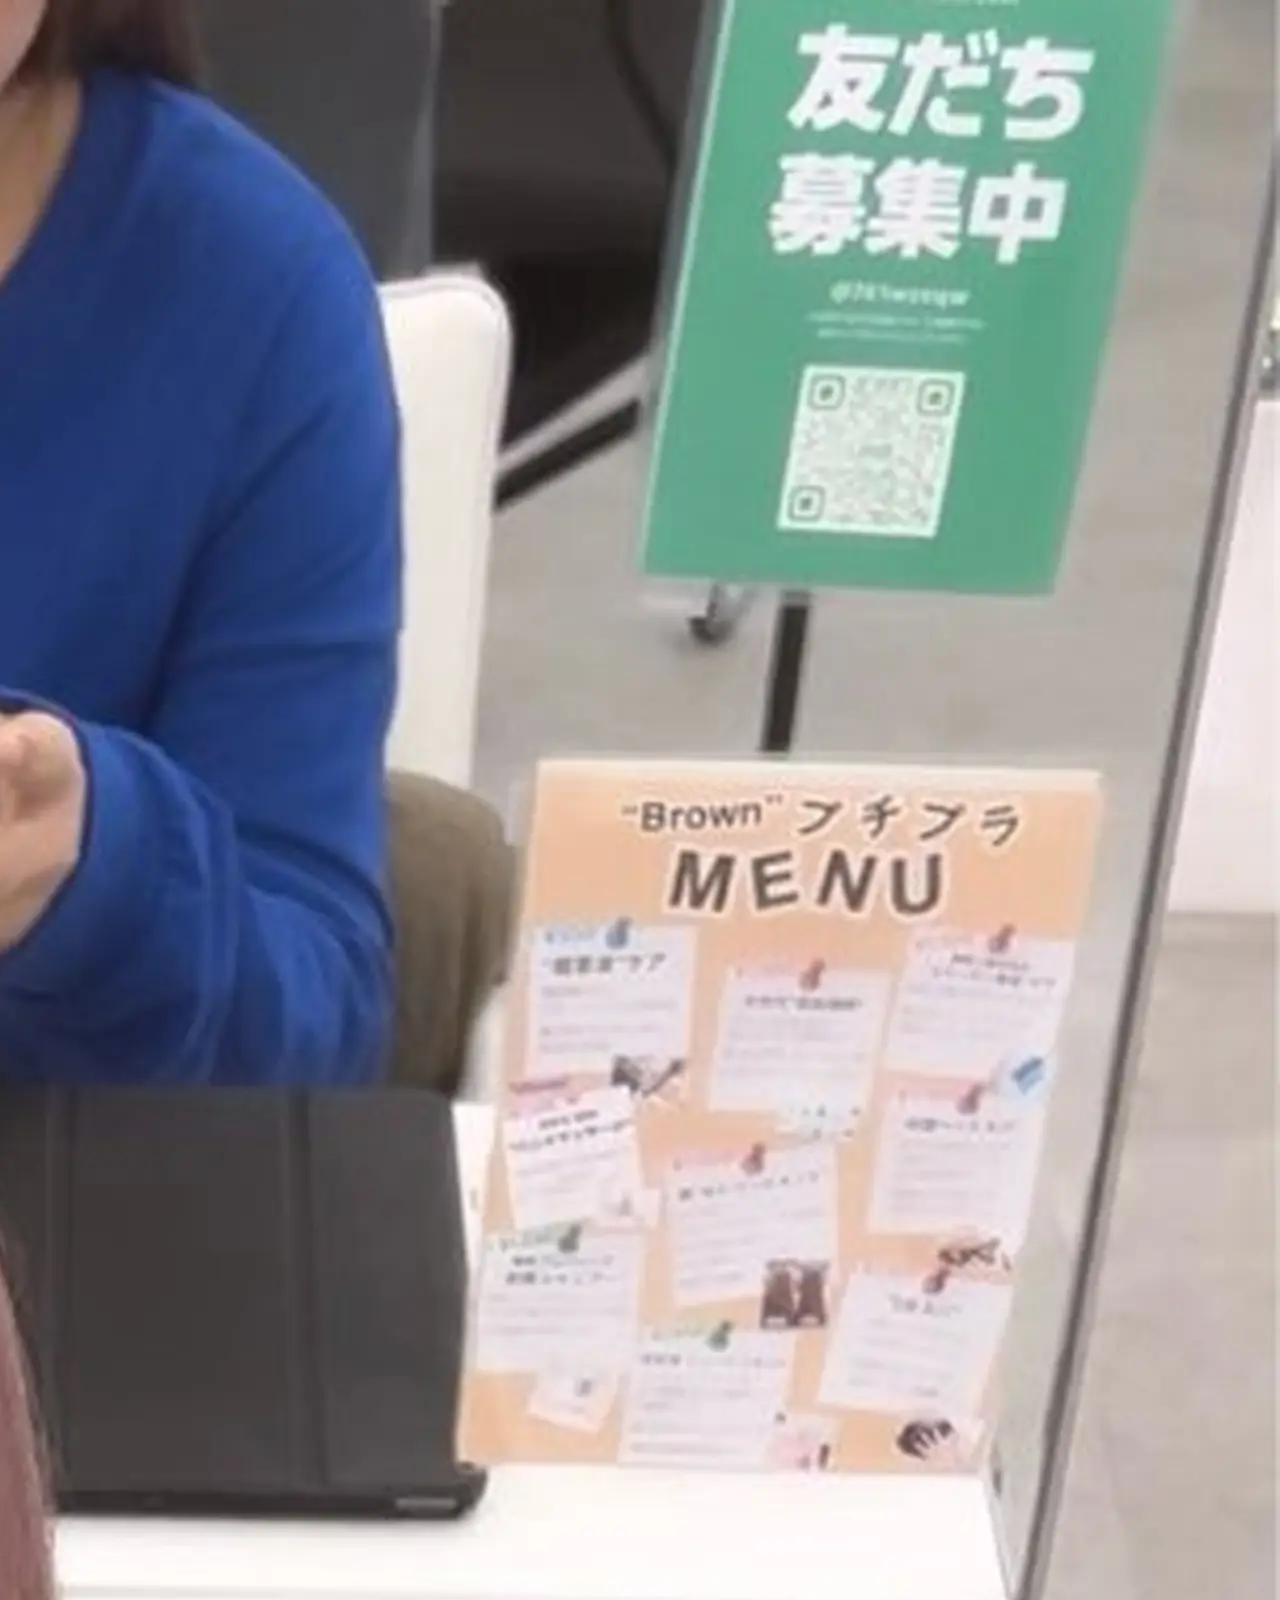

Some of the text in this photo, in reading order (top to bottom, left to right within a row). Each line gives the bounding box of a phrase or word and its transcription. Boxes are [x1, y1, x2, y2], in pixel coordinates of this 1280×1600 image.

[786, 23, 1097, 141] 友だち
[768, 152, 1068, 265] 募集中
[668, 850, 943, 916] MENU
